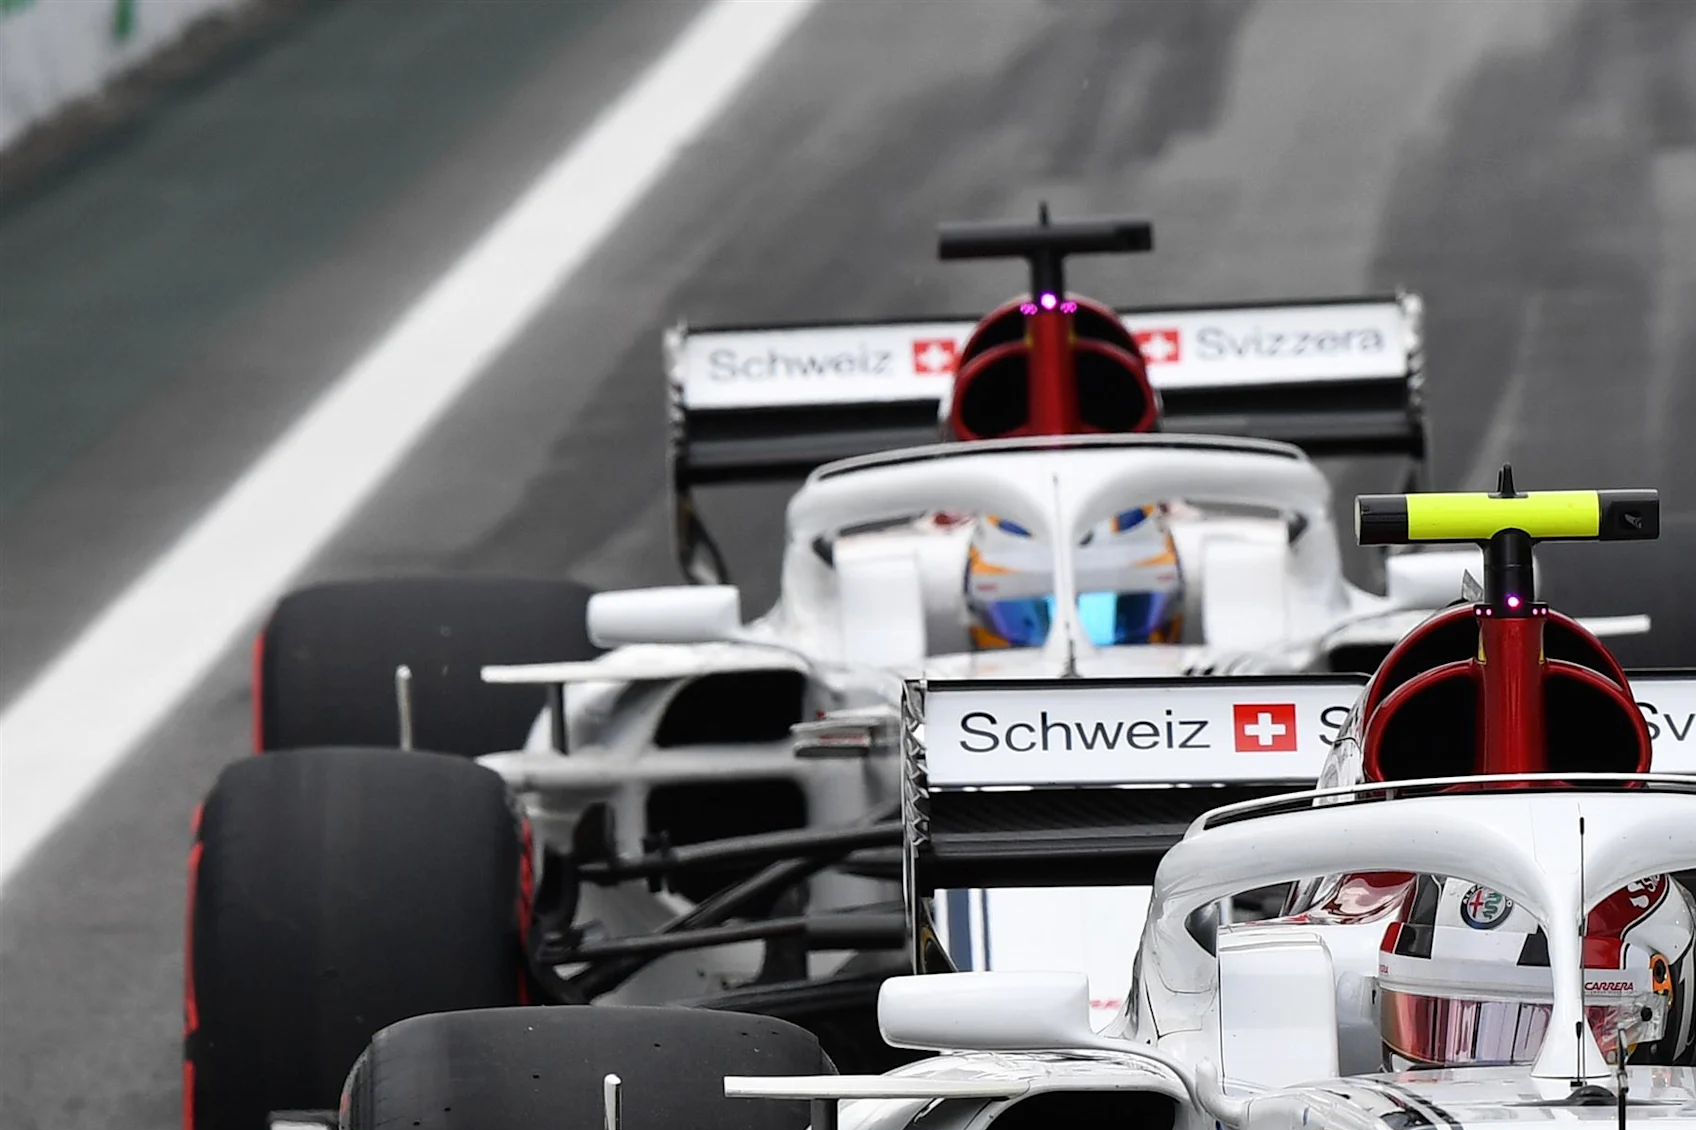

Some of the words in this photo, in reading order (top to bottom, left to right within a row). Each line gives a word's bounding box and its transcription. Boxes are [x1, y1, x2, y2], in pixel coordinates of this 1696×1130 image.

[1196, 325, 1385, 361] Svizzera
[708, 345, 892, 382] Schweiz
[959, 709, 1210, 753] Schweiz
[1584, 981, 1633, 991] CARRERA
